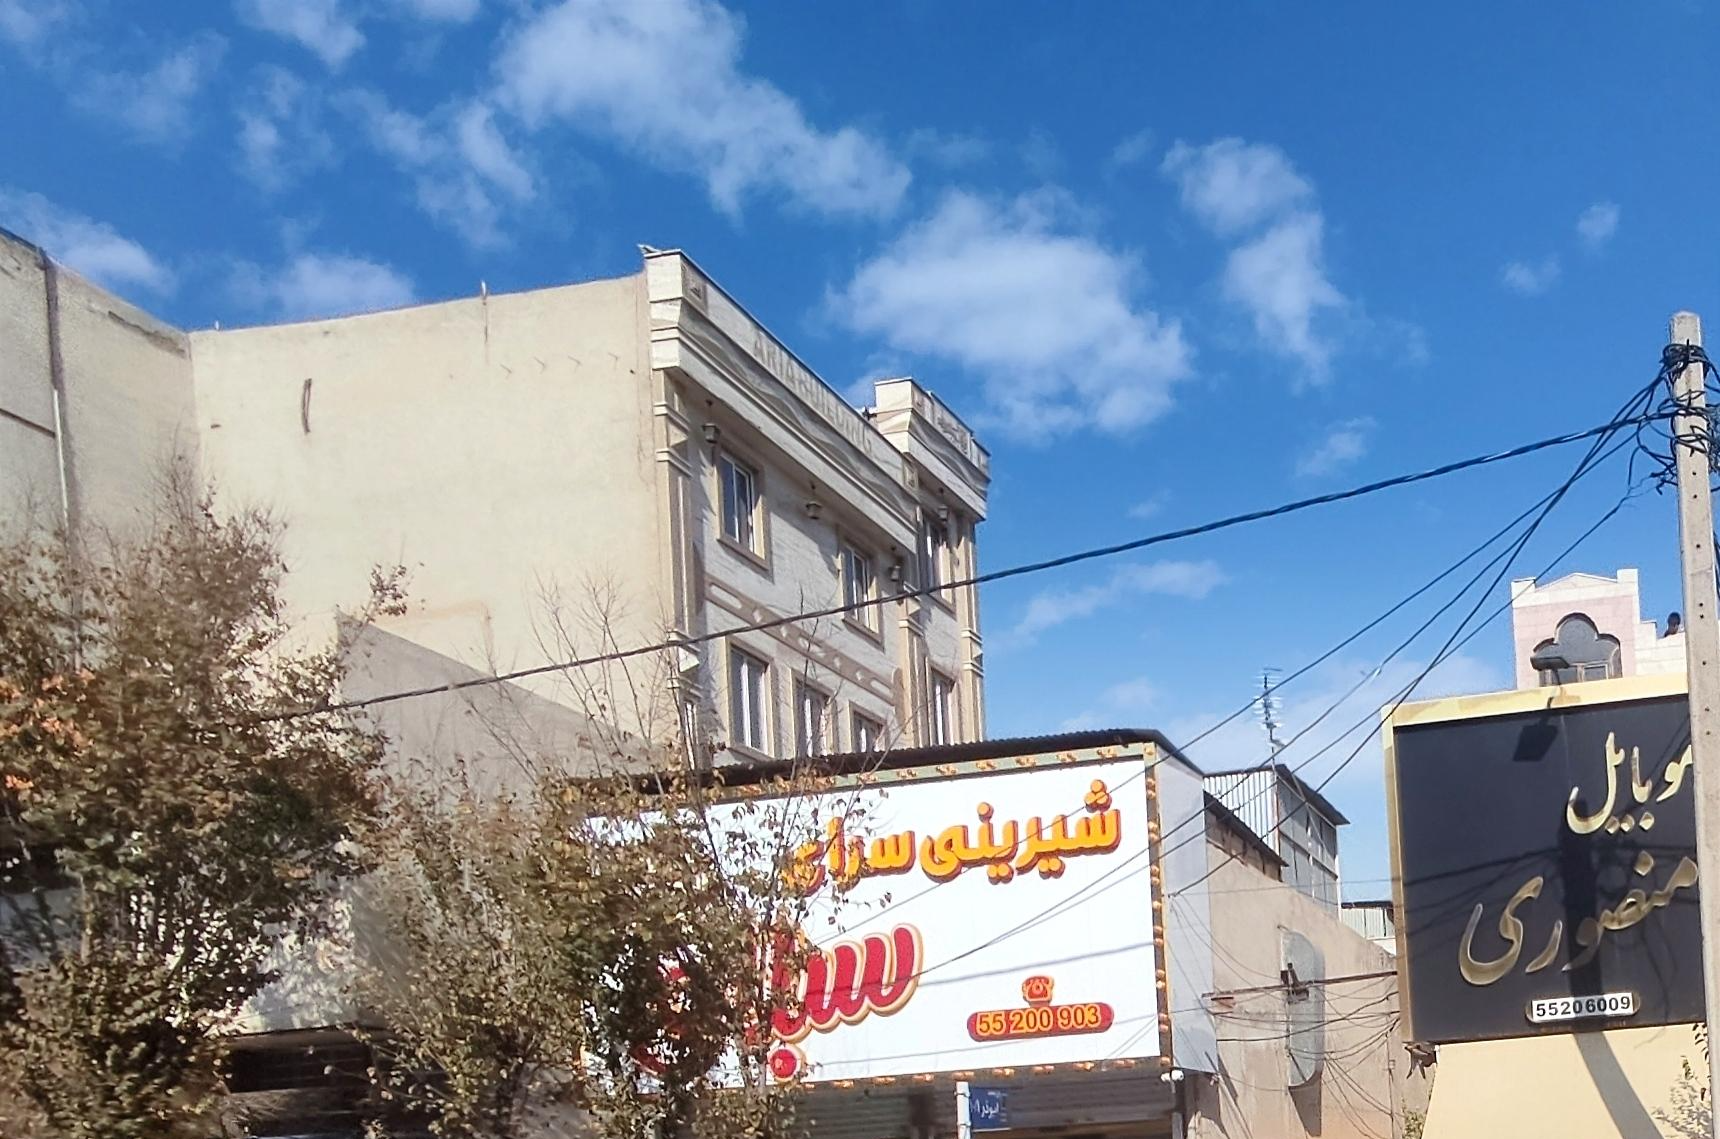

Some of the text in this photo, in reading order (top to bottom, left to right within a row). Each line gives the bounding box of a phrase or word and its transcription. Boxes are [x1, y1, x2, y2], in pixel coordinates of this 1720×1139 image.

[921, 779, 1122, 885] شیرینی
[1459, 851, 1698, 985] منصوری
[1536, 995, 1631, 1017] 55206009
